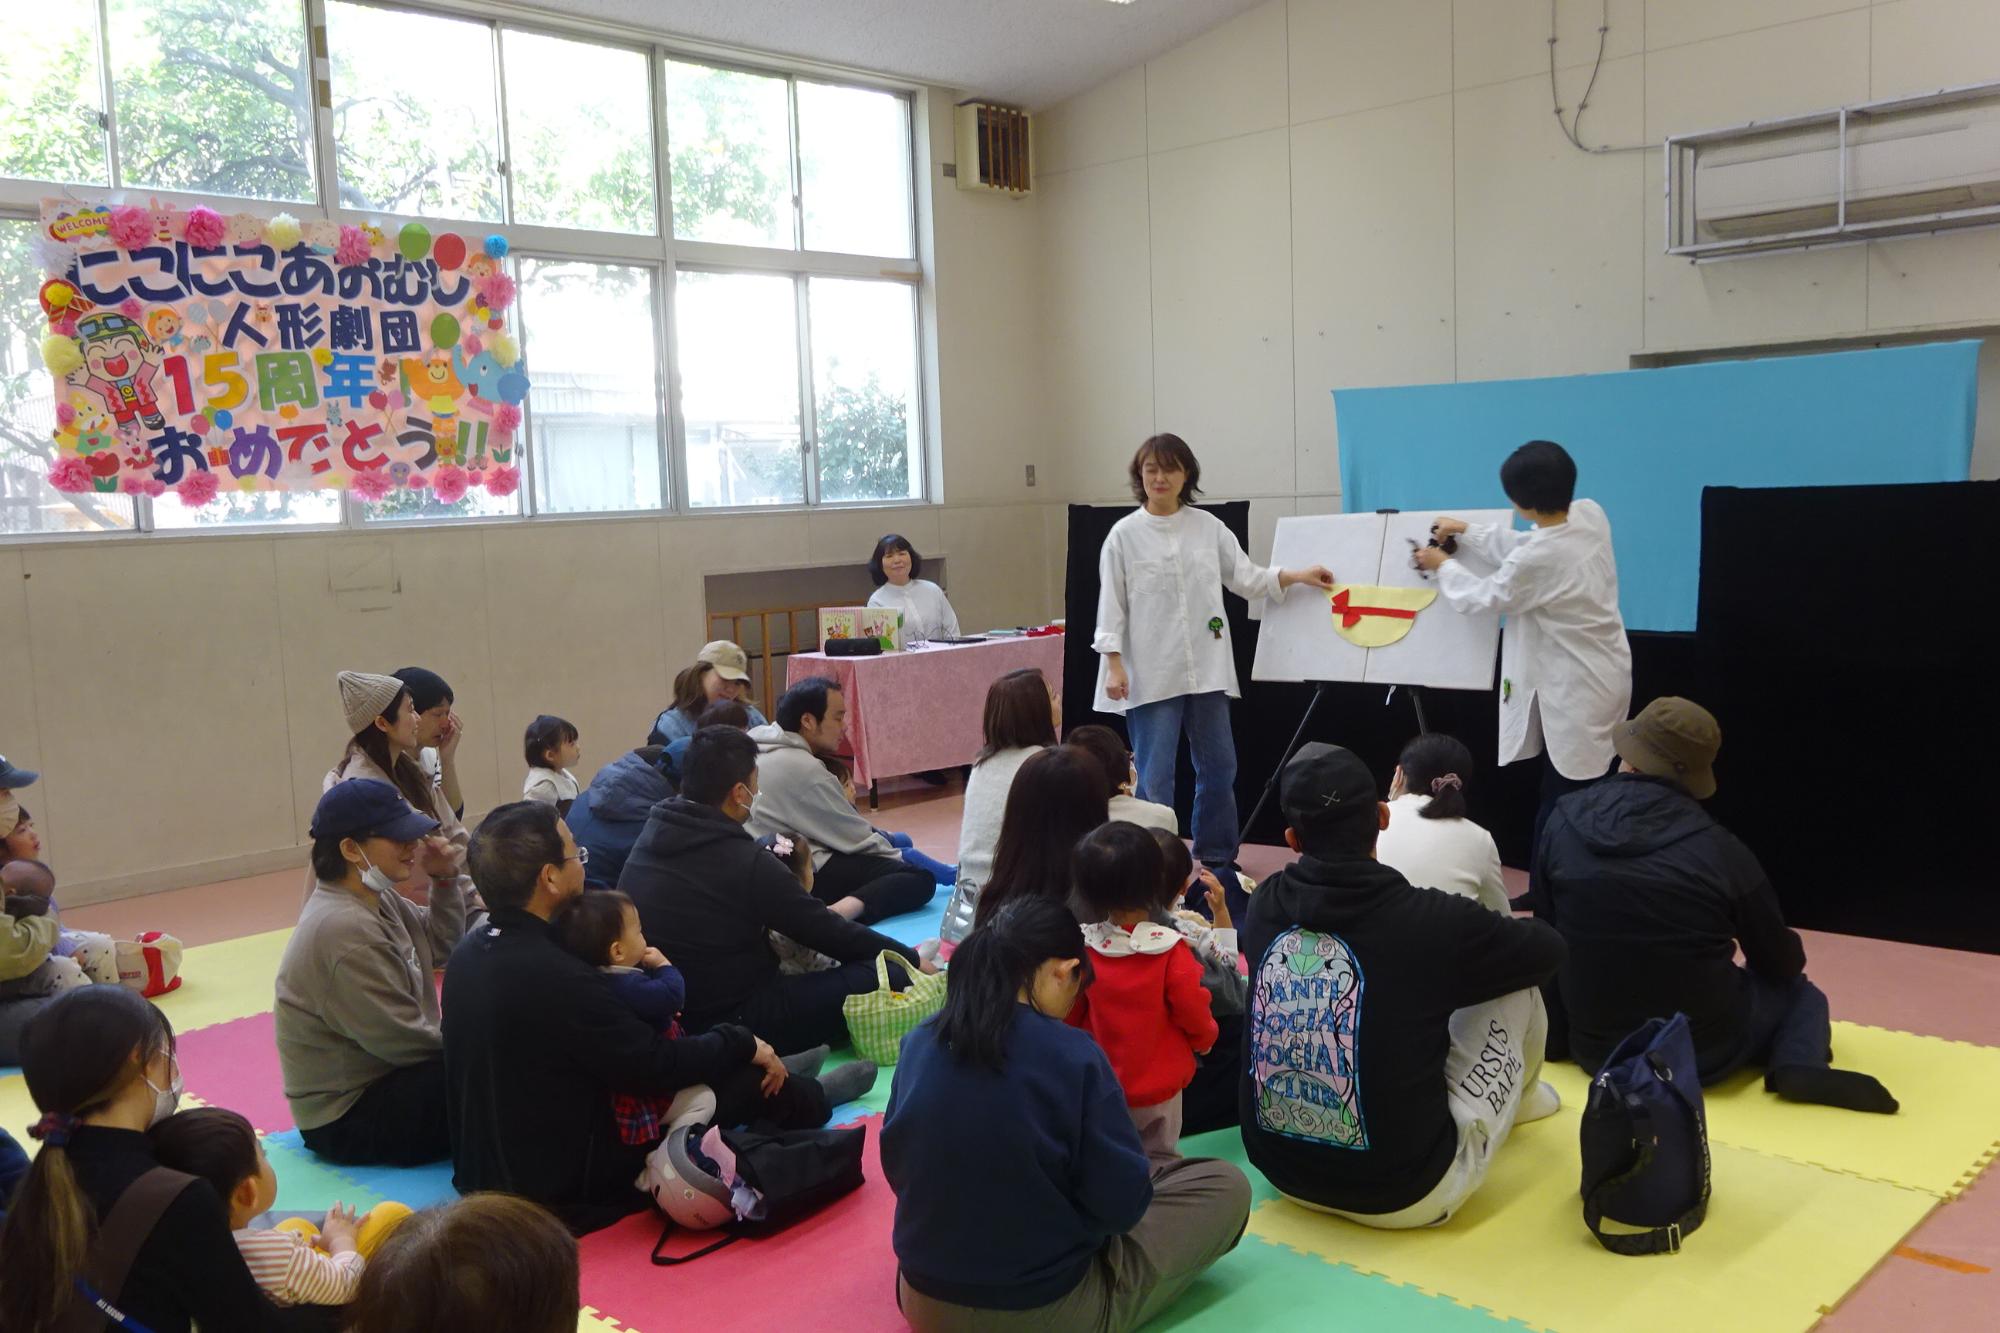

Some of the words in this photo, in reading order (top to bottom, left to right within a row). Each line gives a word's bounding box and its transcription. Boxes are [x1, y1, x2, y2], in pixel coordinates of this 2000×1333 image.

[56, 216, 110, 234] WELCOME
[223, 301, 421, 355] 人形劇団
[1269, 977, 1340, 1004] ANTI
[1253, 1008, 1353, 1035] SOCIAL
[1252, 1041, 1354, 1078] SOCIAL
[1460, 1019, 1509, 1098] URSUS
[1266, 1073, 1341, 1109] CLUB
[1486, 1049, 1522, 1116] BAPE
